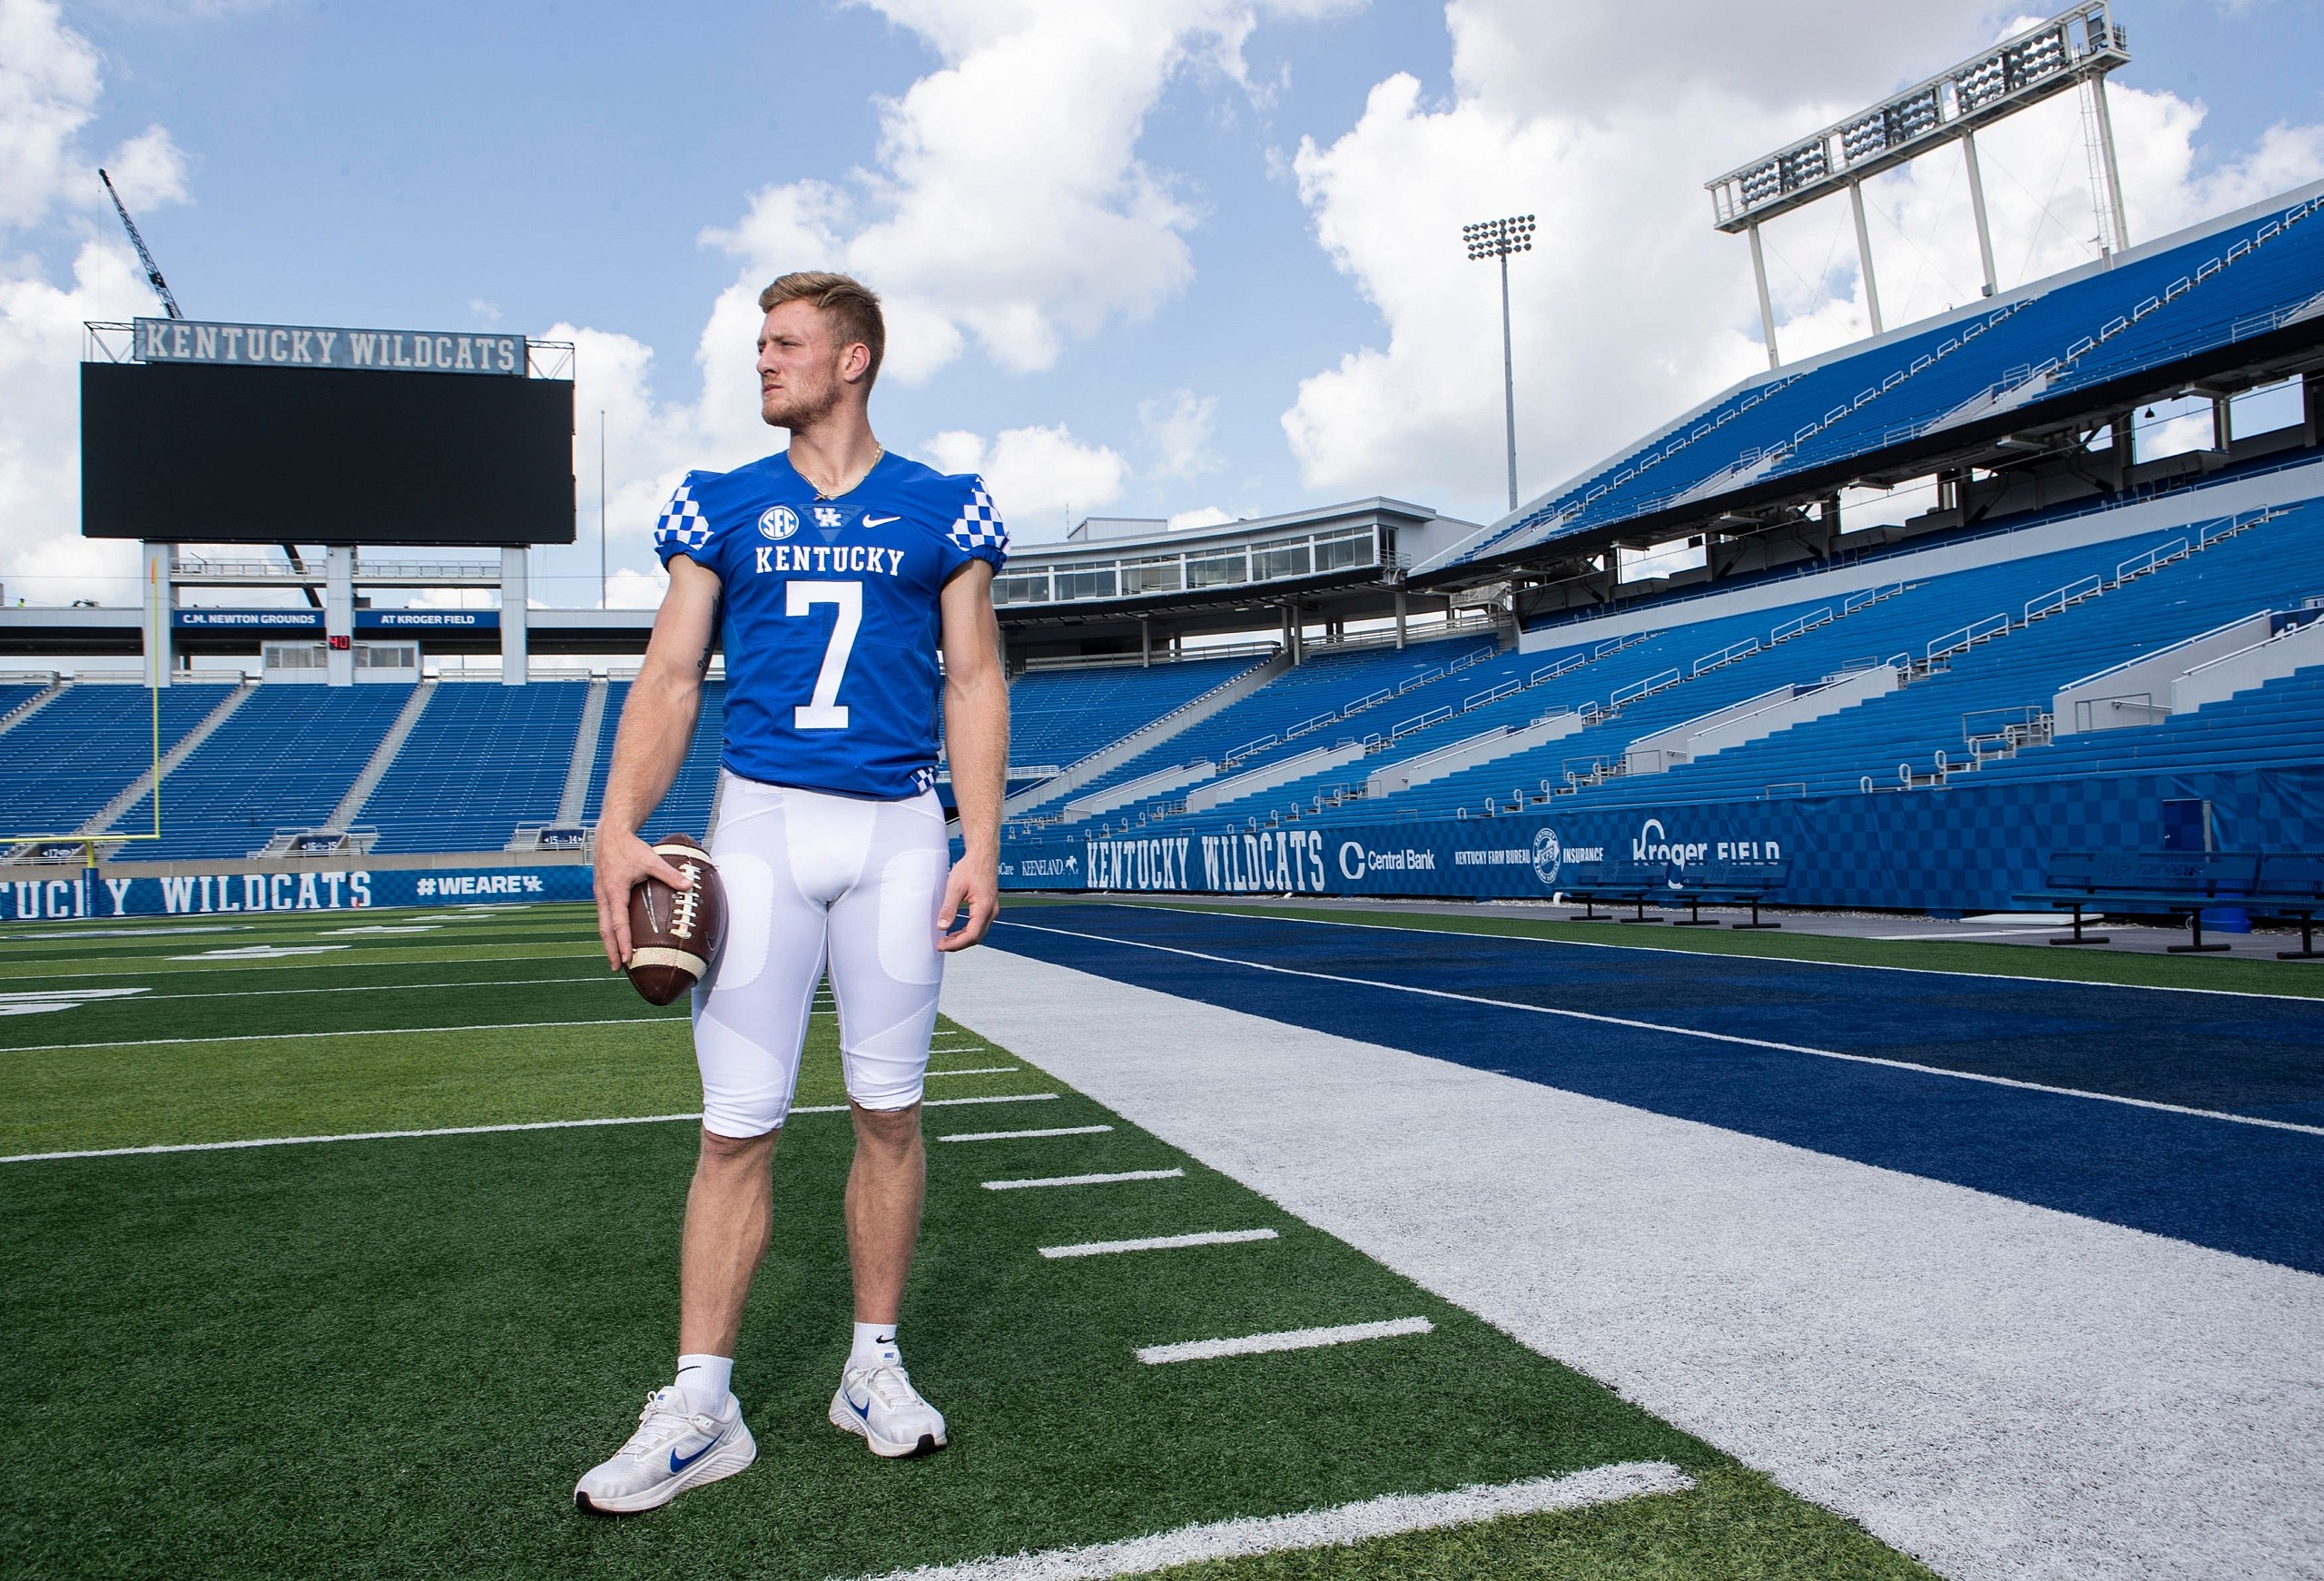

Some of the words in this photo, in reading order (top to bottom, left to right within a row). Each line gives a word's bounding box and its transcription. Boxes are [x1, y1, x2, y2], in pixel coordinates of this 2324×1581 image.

[146, 321, 337, 365] KENTUCKY
[350, 332, 516, 371] WILDCATS
[761, 509, 795, 538] SEC
[755, 546, 904, 577] KENTUCKY
[182, 615, 207, 624] C.M.
[209, 615, 259, 625] NEWTON
[261, 615, 316, 625] GROUNDS
[380, 615, 396, 624] AT
[398, 615, 442, 625] KROGER
[444, 615, 476, 625] FIELD
[329, 636, 350, 649] 40
[785, 580, 862, 729] 7
[1088, 837, 1188, 888] KENTUCKY
[1202, 830, 1325, 891] WILDCATS
[1368, 850, 1404, 870] Central
[1406, 849, 1435, 869] Bank
[1455, 851, 1487, 865] KENTUCKY
[1489, 850, 1504, 865] FARM
[1506, 849, 1531, 864] BUREAU
[1563, 847, 1604, 863] INSURANCE
[1632, 818, 1708, 889] Kroger
[1718, 841, 1780, 865] FIELD
[161, 870, 371, 914] WILDCATS
